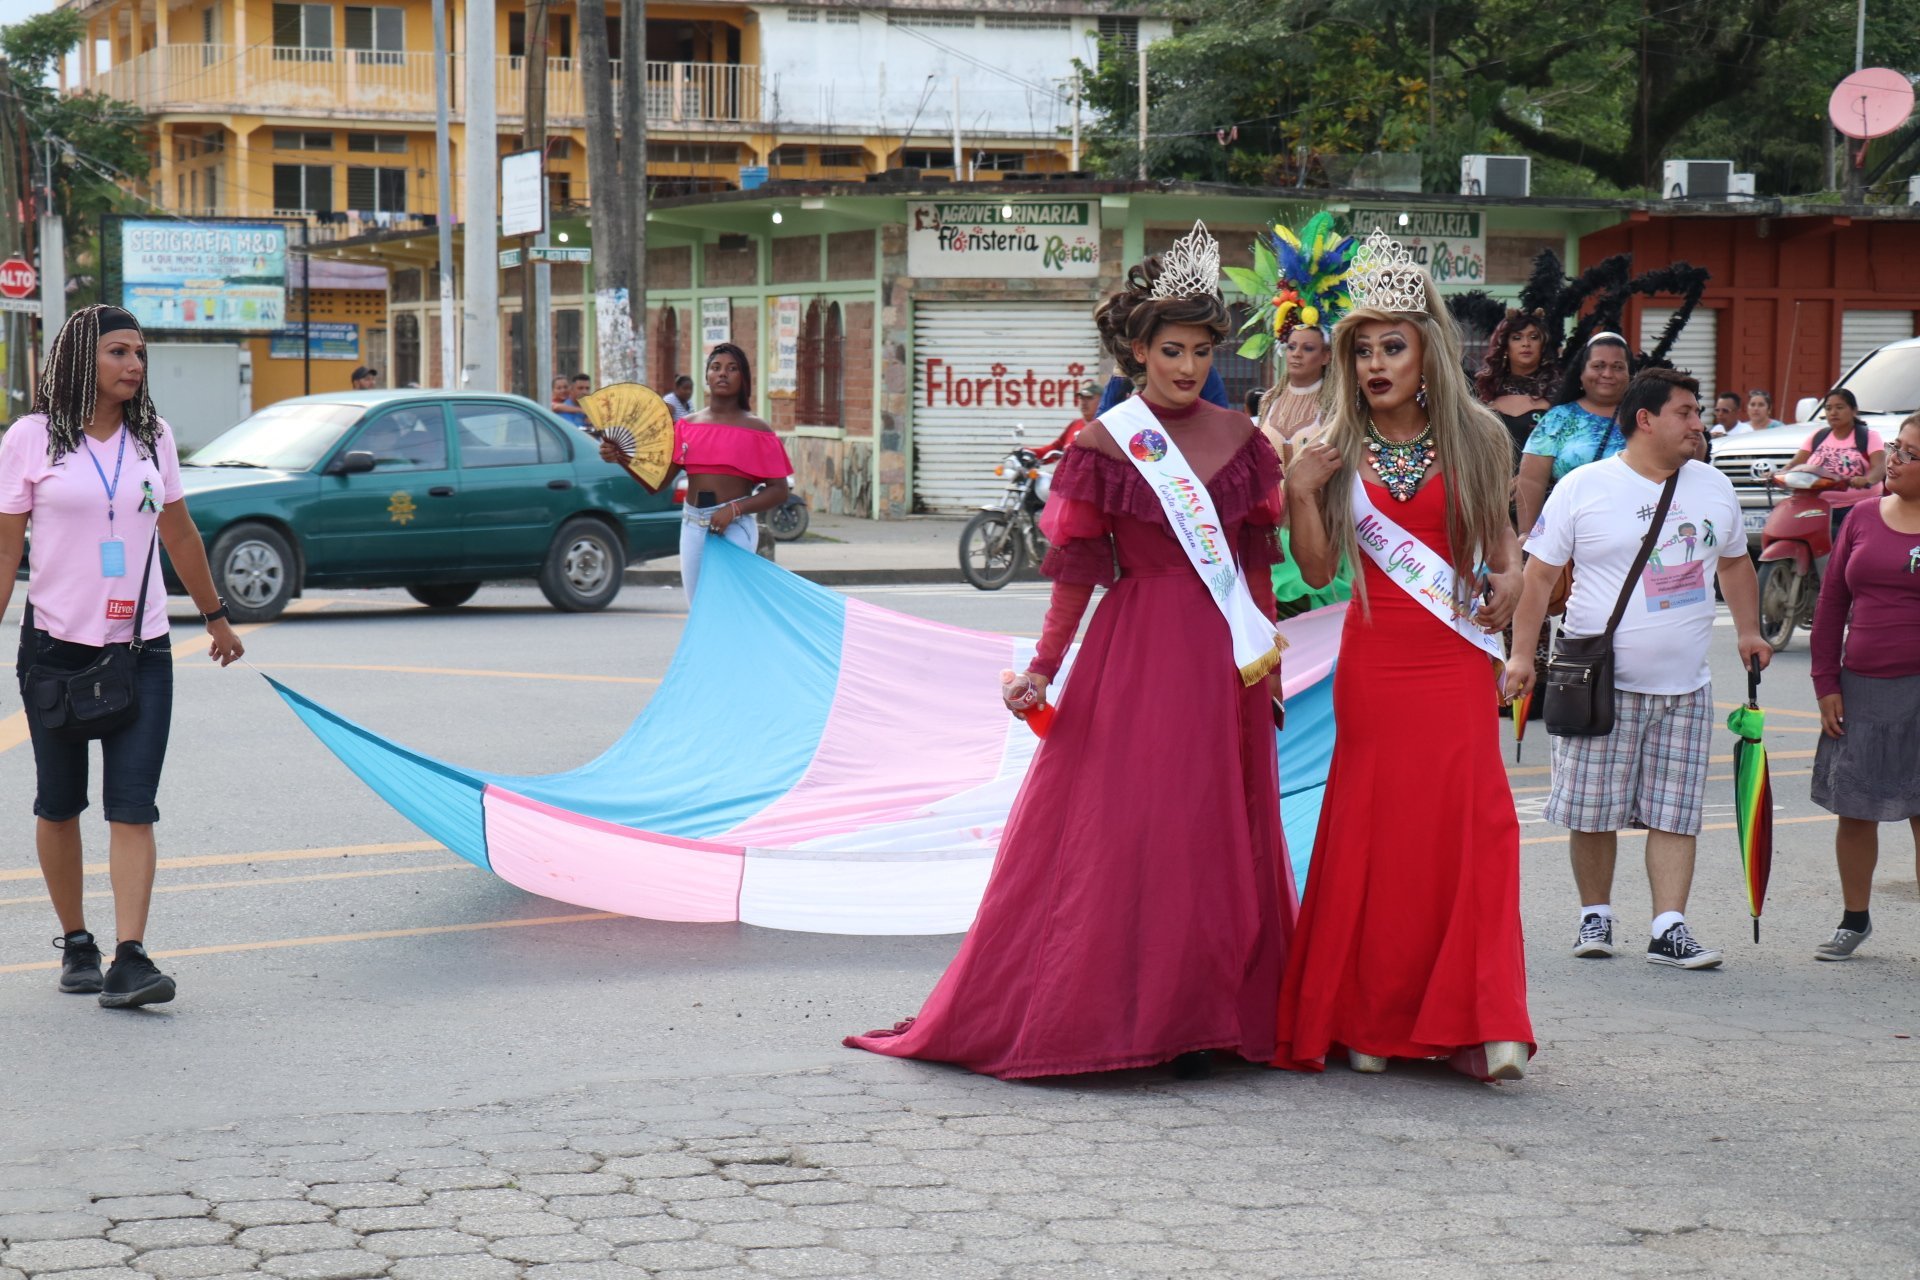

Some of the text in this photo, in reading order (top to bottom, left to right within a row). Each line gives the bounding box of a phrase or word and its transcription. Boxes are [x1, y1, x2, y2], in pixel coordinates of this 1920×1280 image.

[237, 232, 277, 253] M&D
[938, 226, 1039, 252] Floristeria
[0, 269, 32, 288] ALTO
[926, 358, 1092, 408] Floristeri
[1356, 514, 1388, 552] Miss
[1386, 541, 1425, 584] Gay
[109, 602, 134, 613] Hivos
